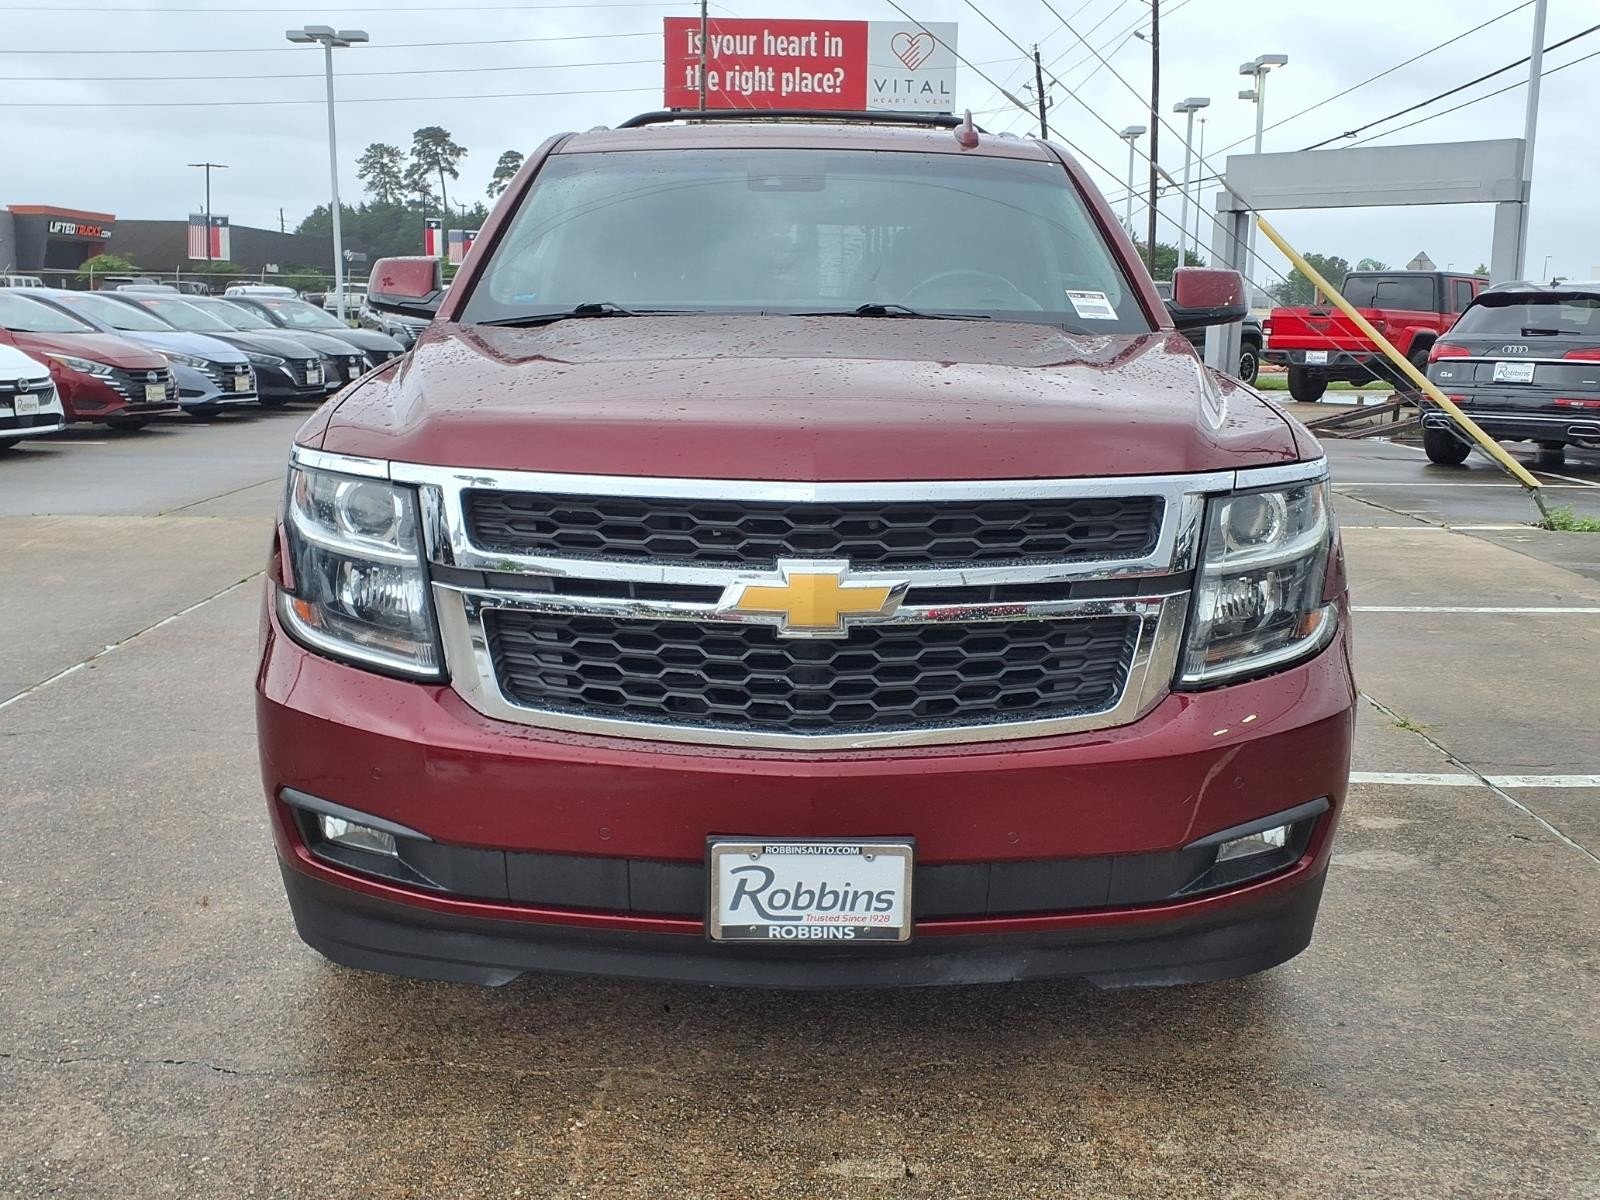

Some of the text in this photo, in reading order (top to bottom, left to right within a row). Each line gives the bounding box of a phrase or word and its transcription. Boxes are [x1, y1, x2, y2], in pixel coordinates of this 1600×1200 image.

[710, 34, 757, 59] your
[763, 29, 818, 57] heart
[824, 31, 843, 57] in
[725, 64, 775, 96] right
[781, 66, 845, 97] place?
[873, 79, 950, 95] VITAL
[765, 846, 860, 855] ROBBINSAUTO.COM
[729, 865, 896, 922] Robbins
[806, 914, 891, 923] Trusted Since 1928
[768, 925, 856, 940] ROBBINS
